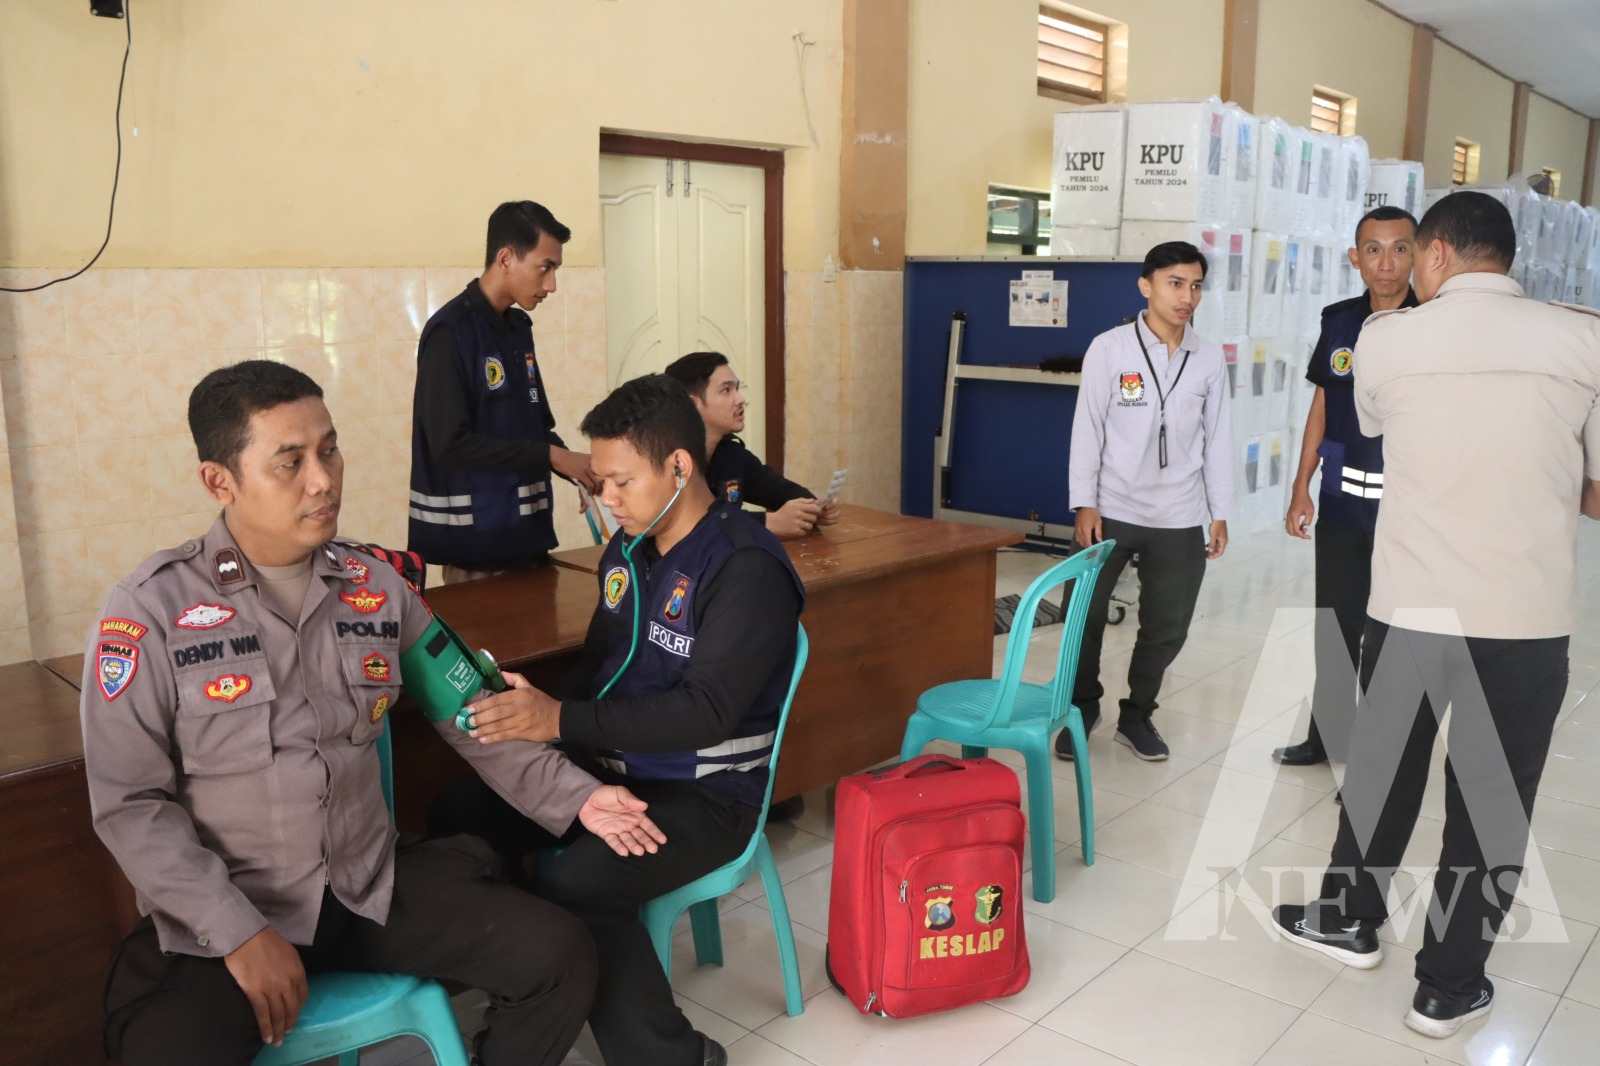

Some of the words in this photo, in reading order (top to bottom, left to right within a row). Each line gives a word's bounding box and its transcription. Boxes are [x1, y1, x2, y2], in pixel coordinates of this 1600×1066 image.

[1064, 151, 1105, 171] KPU
[1139, 144, 1184, 165] KPU
[1069, 175, 1100, 183] PEMILU
[1144, 168, 1178, 176] PEMILU
[1060, 184, 1087, 192] TAHUN
[1089, 184, 1109, 192] 2024
[1134, 178, 1163, 186] TAHUN
[1165, 178, 1188, 186] 2024
[336, 621, 399, 640] POLRI
[652, 625, 691, 654] POLRI
[174, 640, 224, 669] DENDY
[229, 634, 261, 656] WM
[919, 927, 1005, 960] KESLAP
